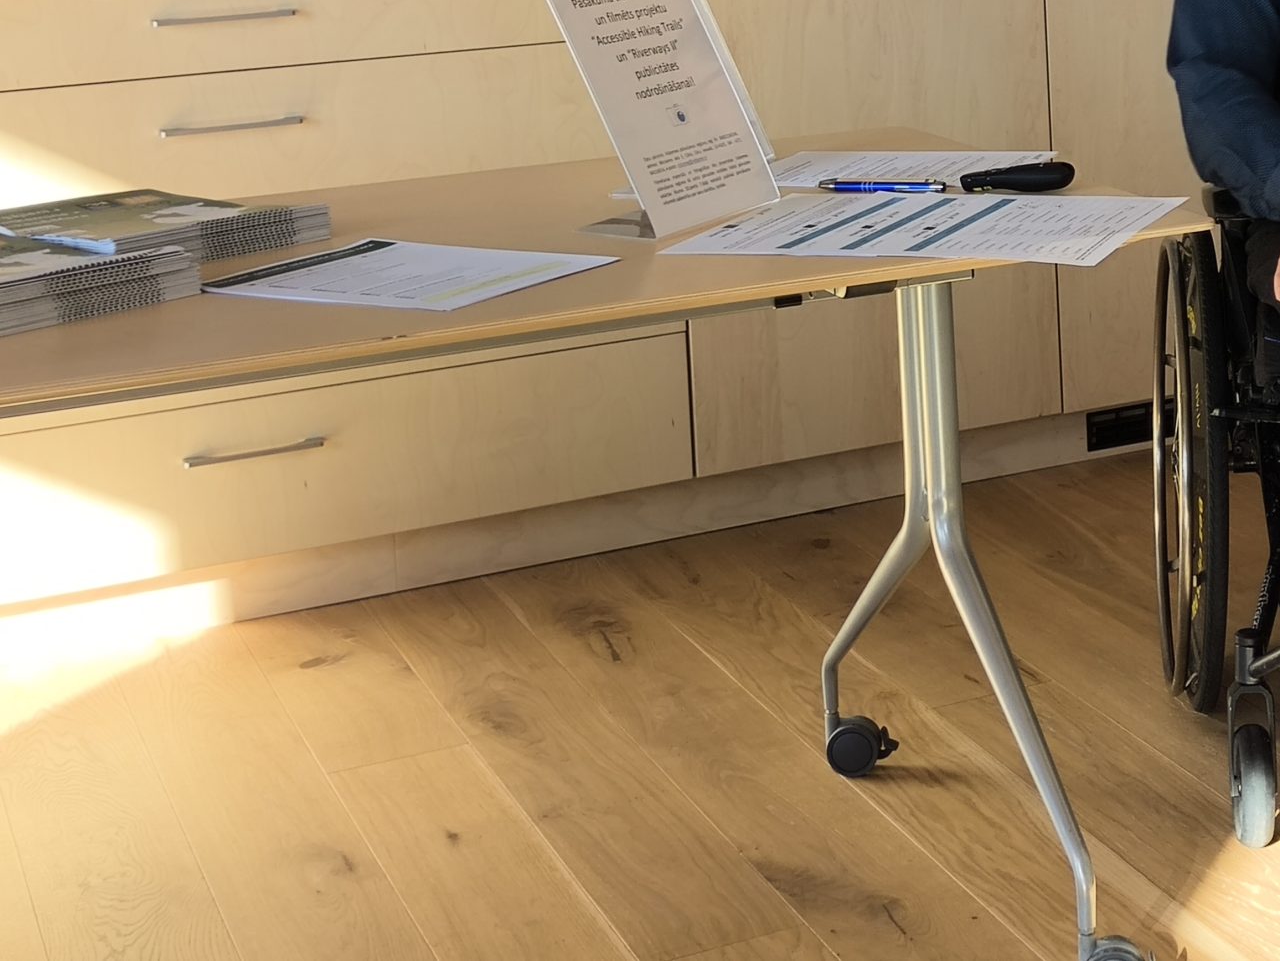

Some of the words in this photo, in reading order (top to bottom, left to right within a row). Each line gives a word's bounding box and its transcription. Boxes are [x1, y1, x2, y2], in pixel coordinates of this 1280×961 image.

[594, 15, 607, 26] un
[606, 9, 635, 23] filmēts
[635, 4, 668, 20] projektu
[636, 25, 663, 36] Hiking
[616, 52, 628, 63] un
[635, 62, 680, 81] publicitātes
